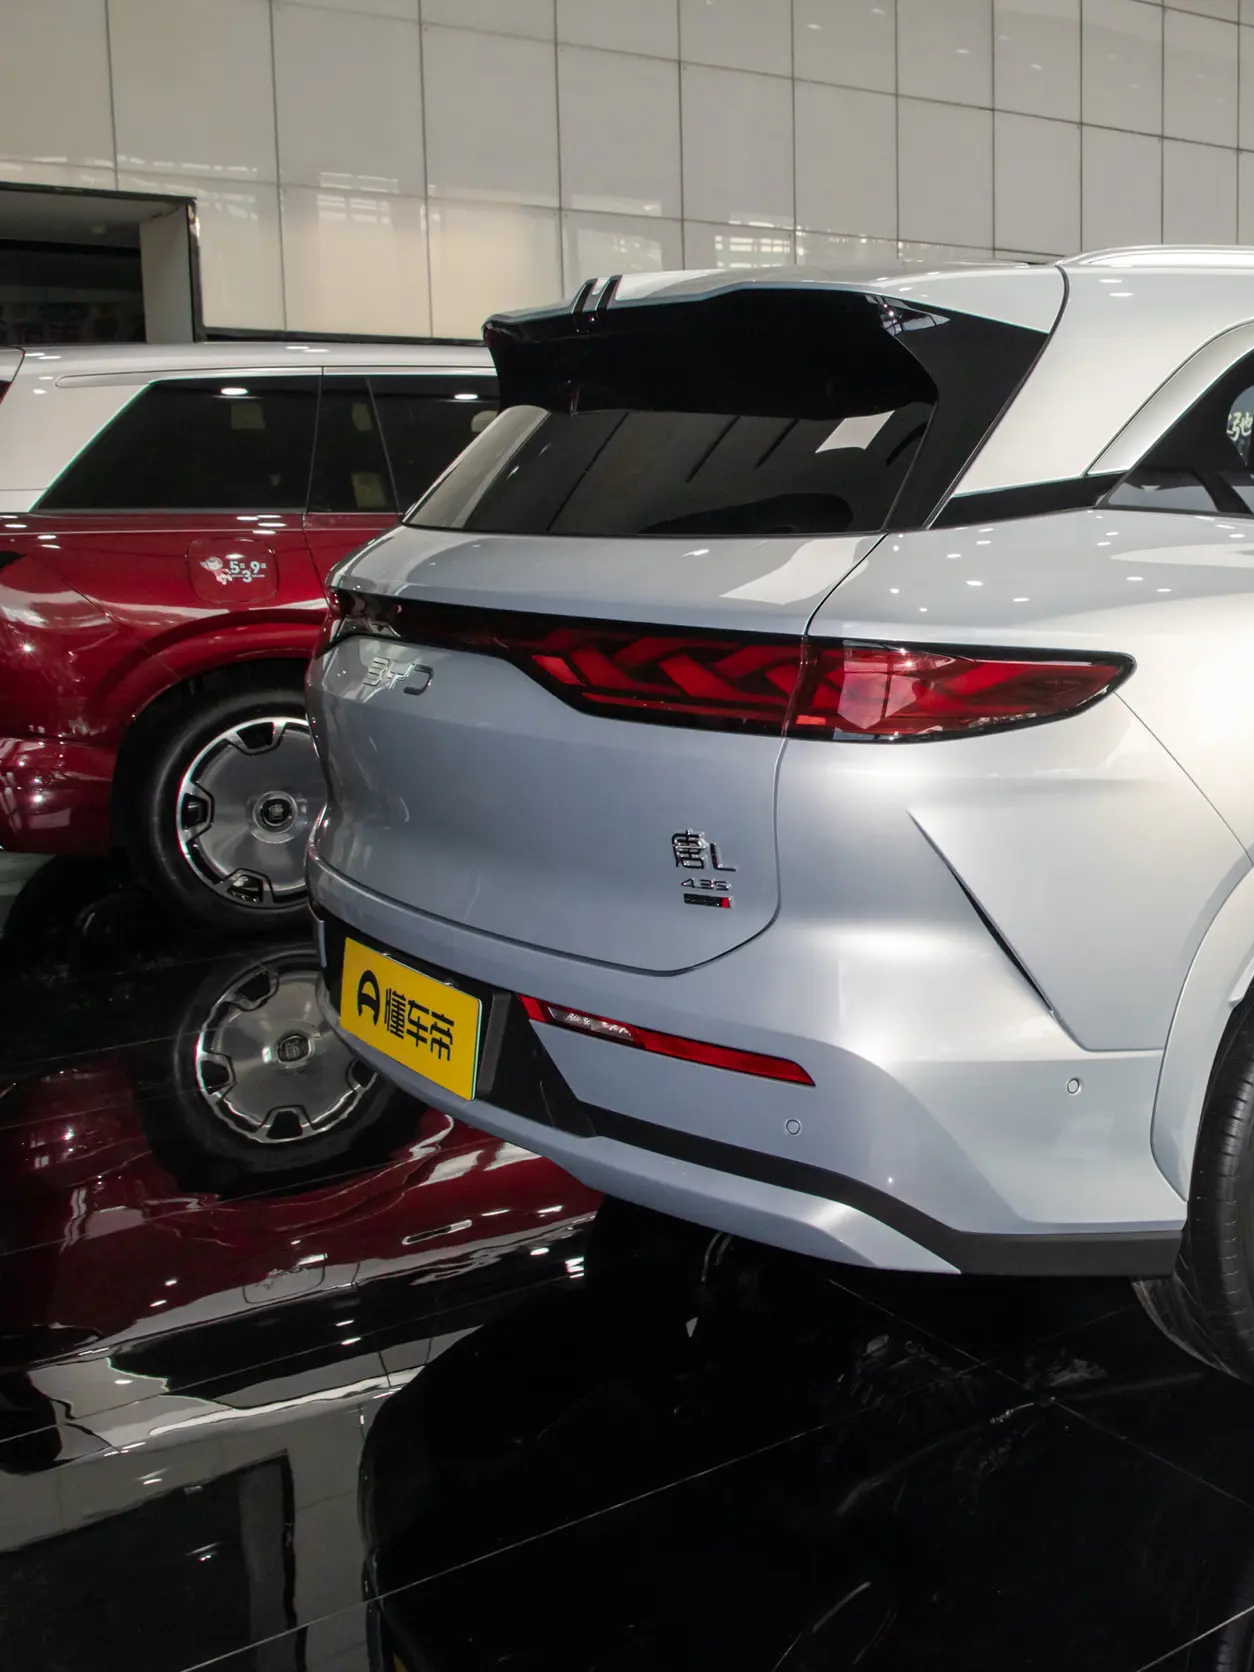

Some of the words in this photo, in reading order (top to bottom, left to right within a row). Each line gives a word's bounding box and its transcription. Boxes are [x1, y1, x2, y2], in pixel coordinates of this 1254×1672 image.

[362, 656, 435, 696] BYD
[384, 987, 456, 1062] 懂车帝
